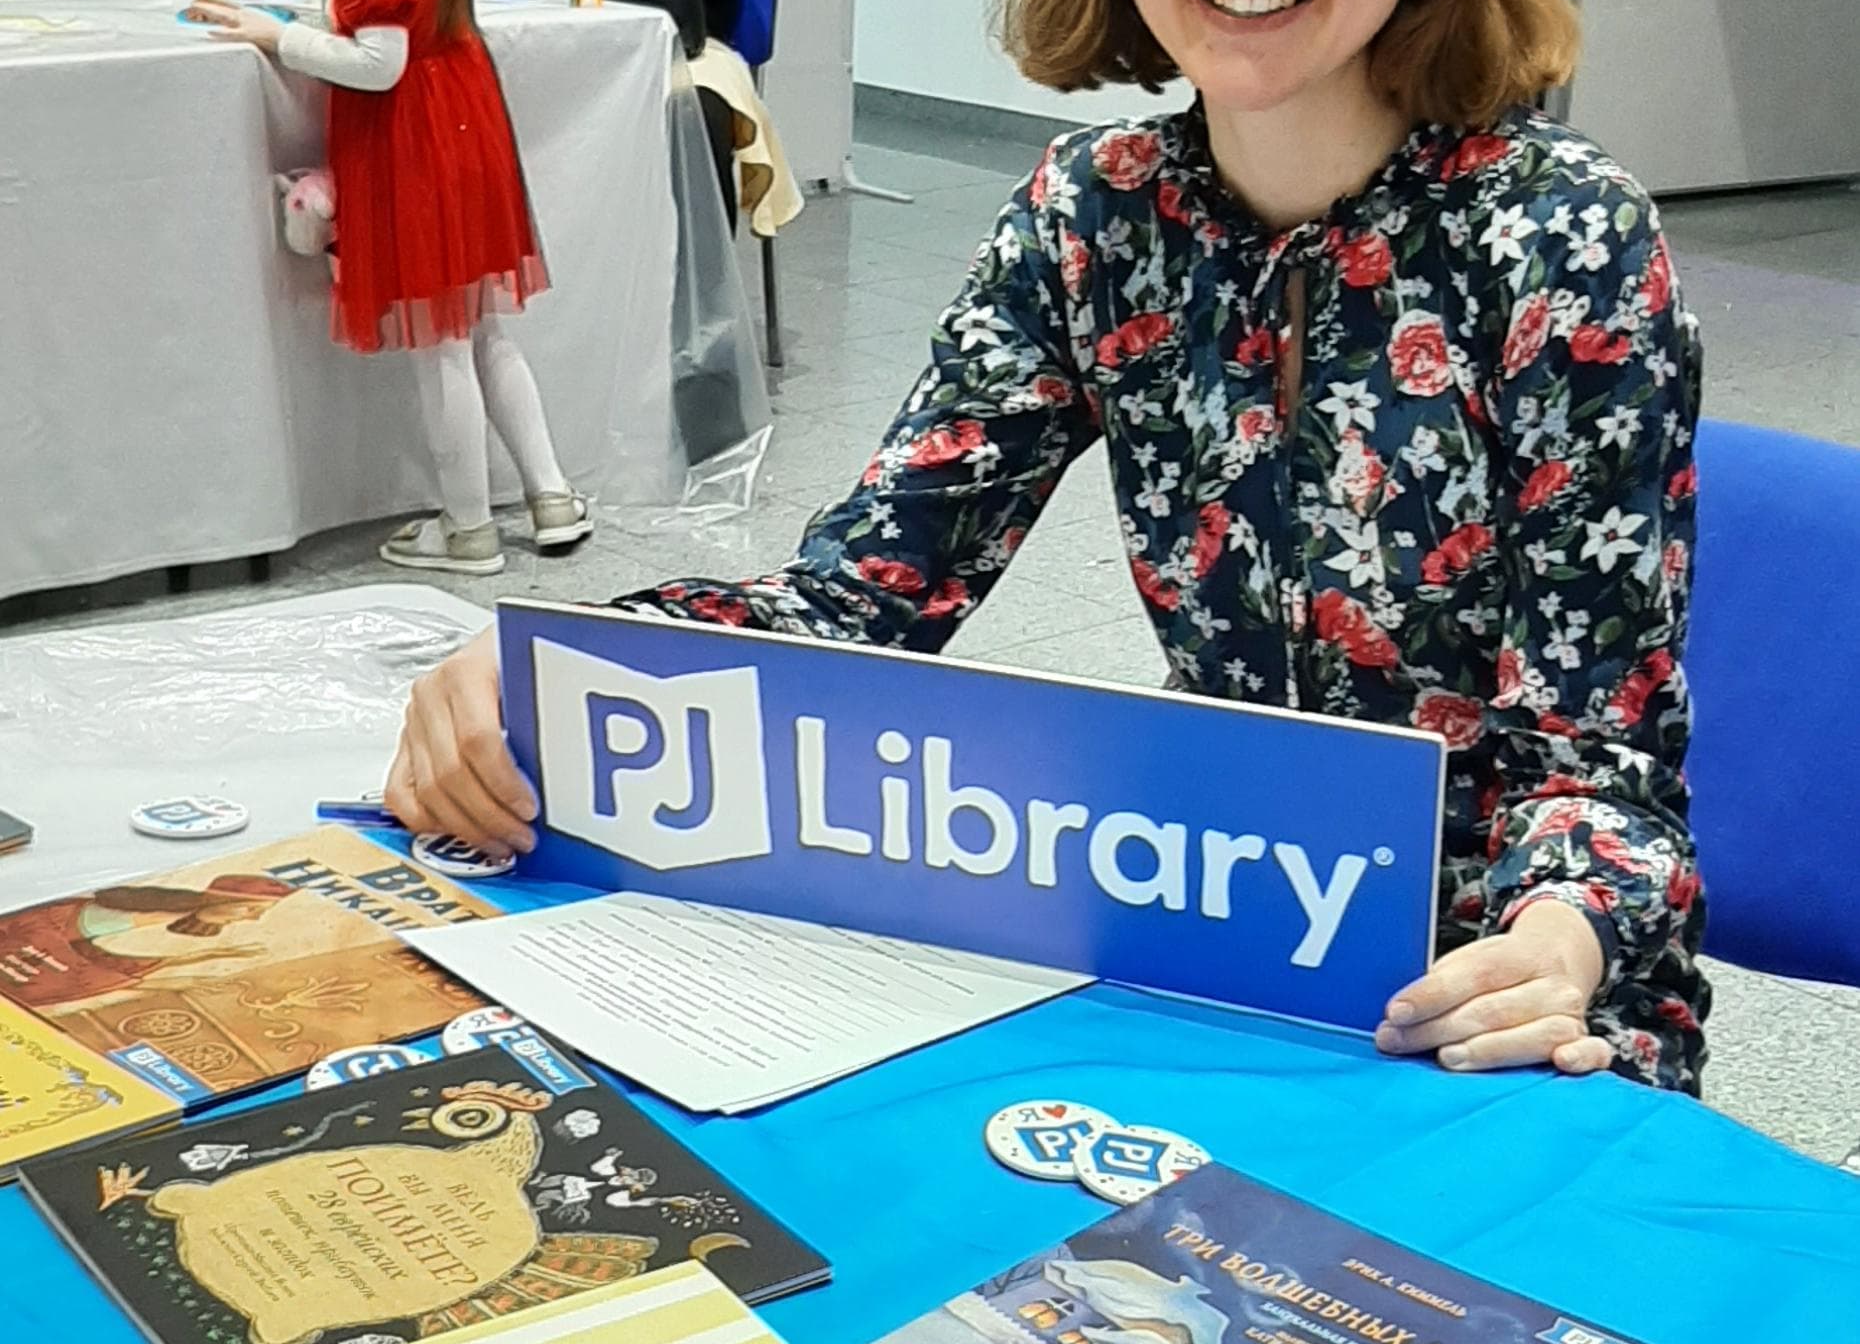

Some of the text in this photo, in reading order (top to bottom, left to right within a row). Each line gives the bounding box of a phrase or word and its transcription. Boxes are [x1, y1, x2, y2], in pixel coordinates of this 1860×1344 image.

[586, 690, 1369, 968] PJ Library
[307, 1188, 347, 1210] 28
[326, 1156, 479, 1287] ПОЙМЁТЕ?
[398, 1172, 490, 1249] ВЫ МЕНЯ
[447, 1181, 497, 1222] ВЕДЬ
[1163, 1224, 1225, 1261] ТРИ
